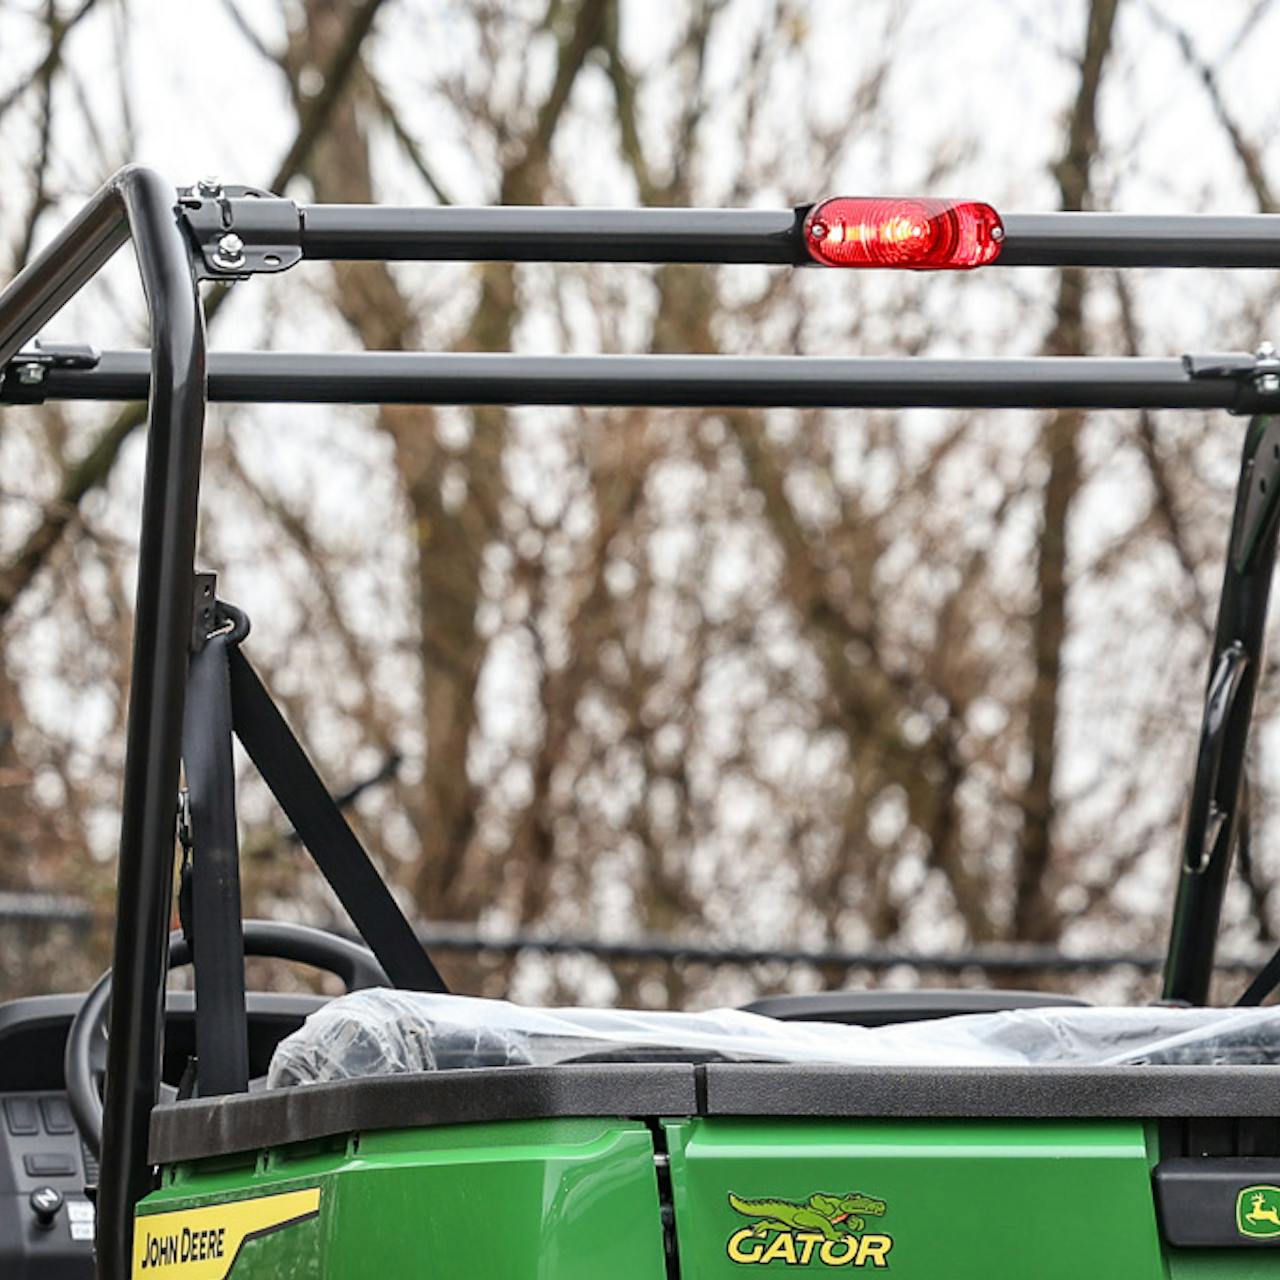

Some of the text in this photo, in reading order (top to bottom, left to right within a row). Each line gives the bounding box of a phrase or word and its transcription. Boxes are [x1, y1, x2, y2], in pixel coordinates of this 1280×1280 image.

[142, 1227, 225, 1268] JOHN DEERE
[727, 1228, 893, 1268] GATOR
